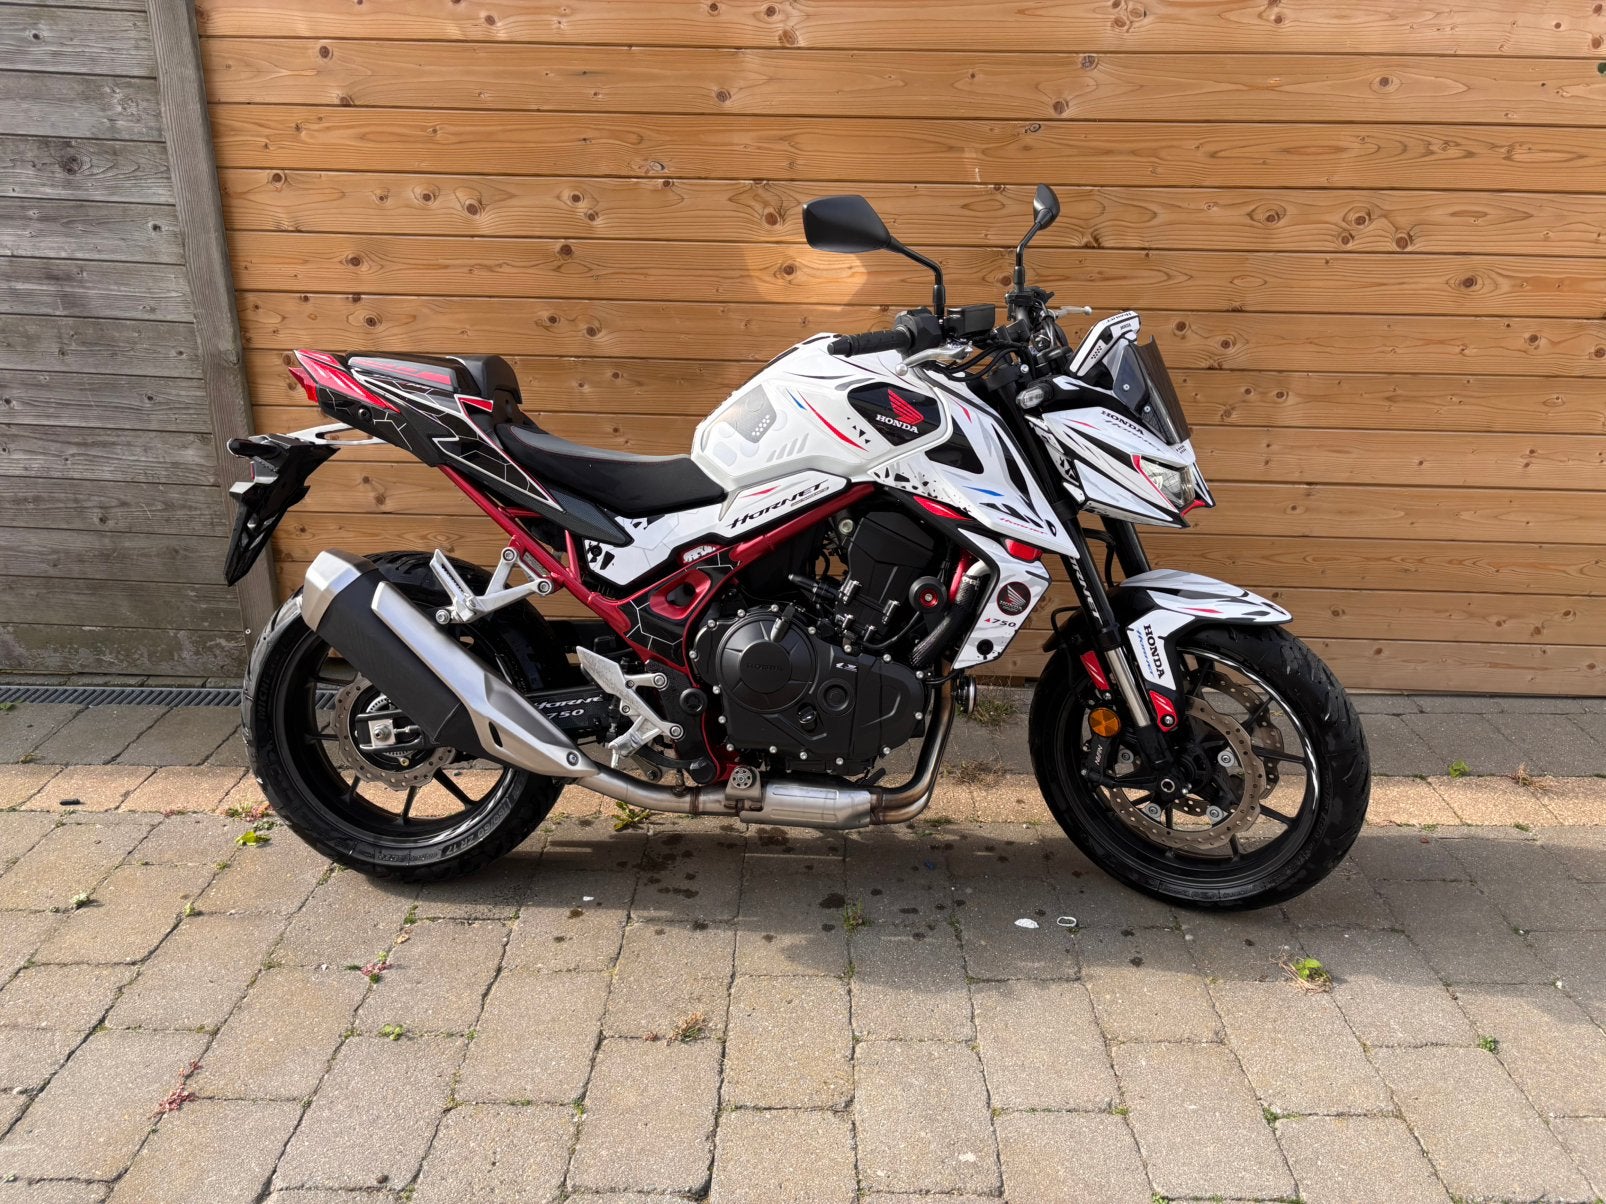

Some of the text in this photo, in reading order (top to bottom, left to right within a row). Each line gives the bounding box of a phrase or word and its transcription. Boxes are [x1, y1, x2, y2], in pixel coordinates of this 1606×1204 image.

[875, 413, 919, 434] HONDA
[1101, 410, 1145, 436] HONDA
[725, 478, 829, 529] HORNET
[992, 618, 1017, 628] 750
[1143, 623, 1166, 680] HONDA
[547, 708, 585, 720] 750
[446, 843, 458, 854] 17
